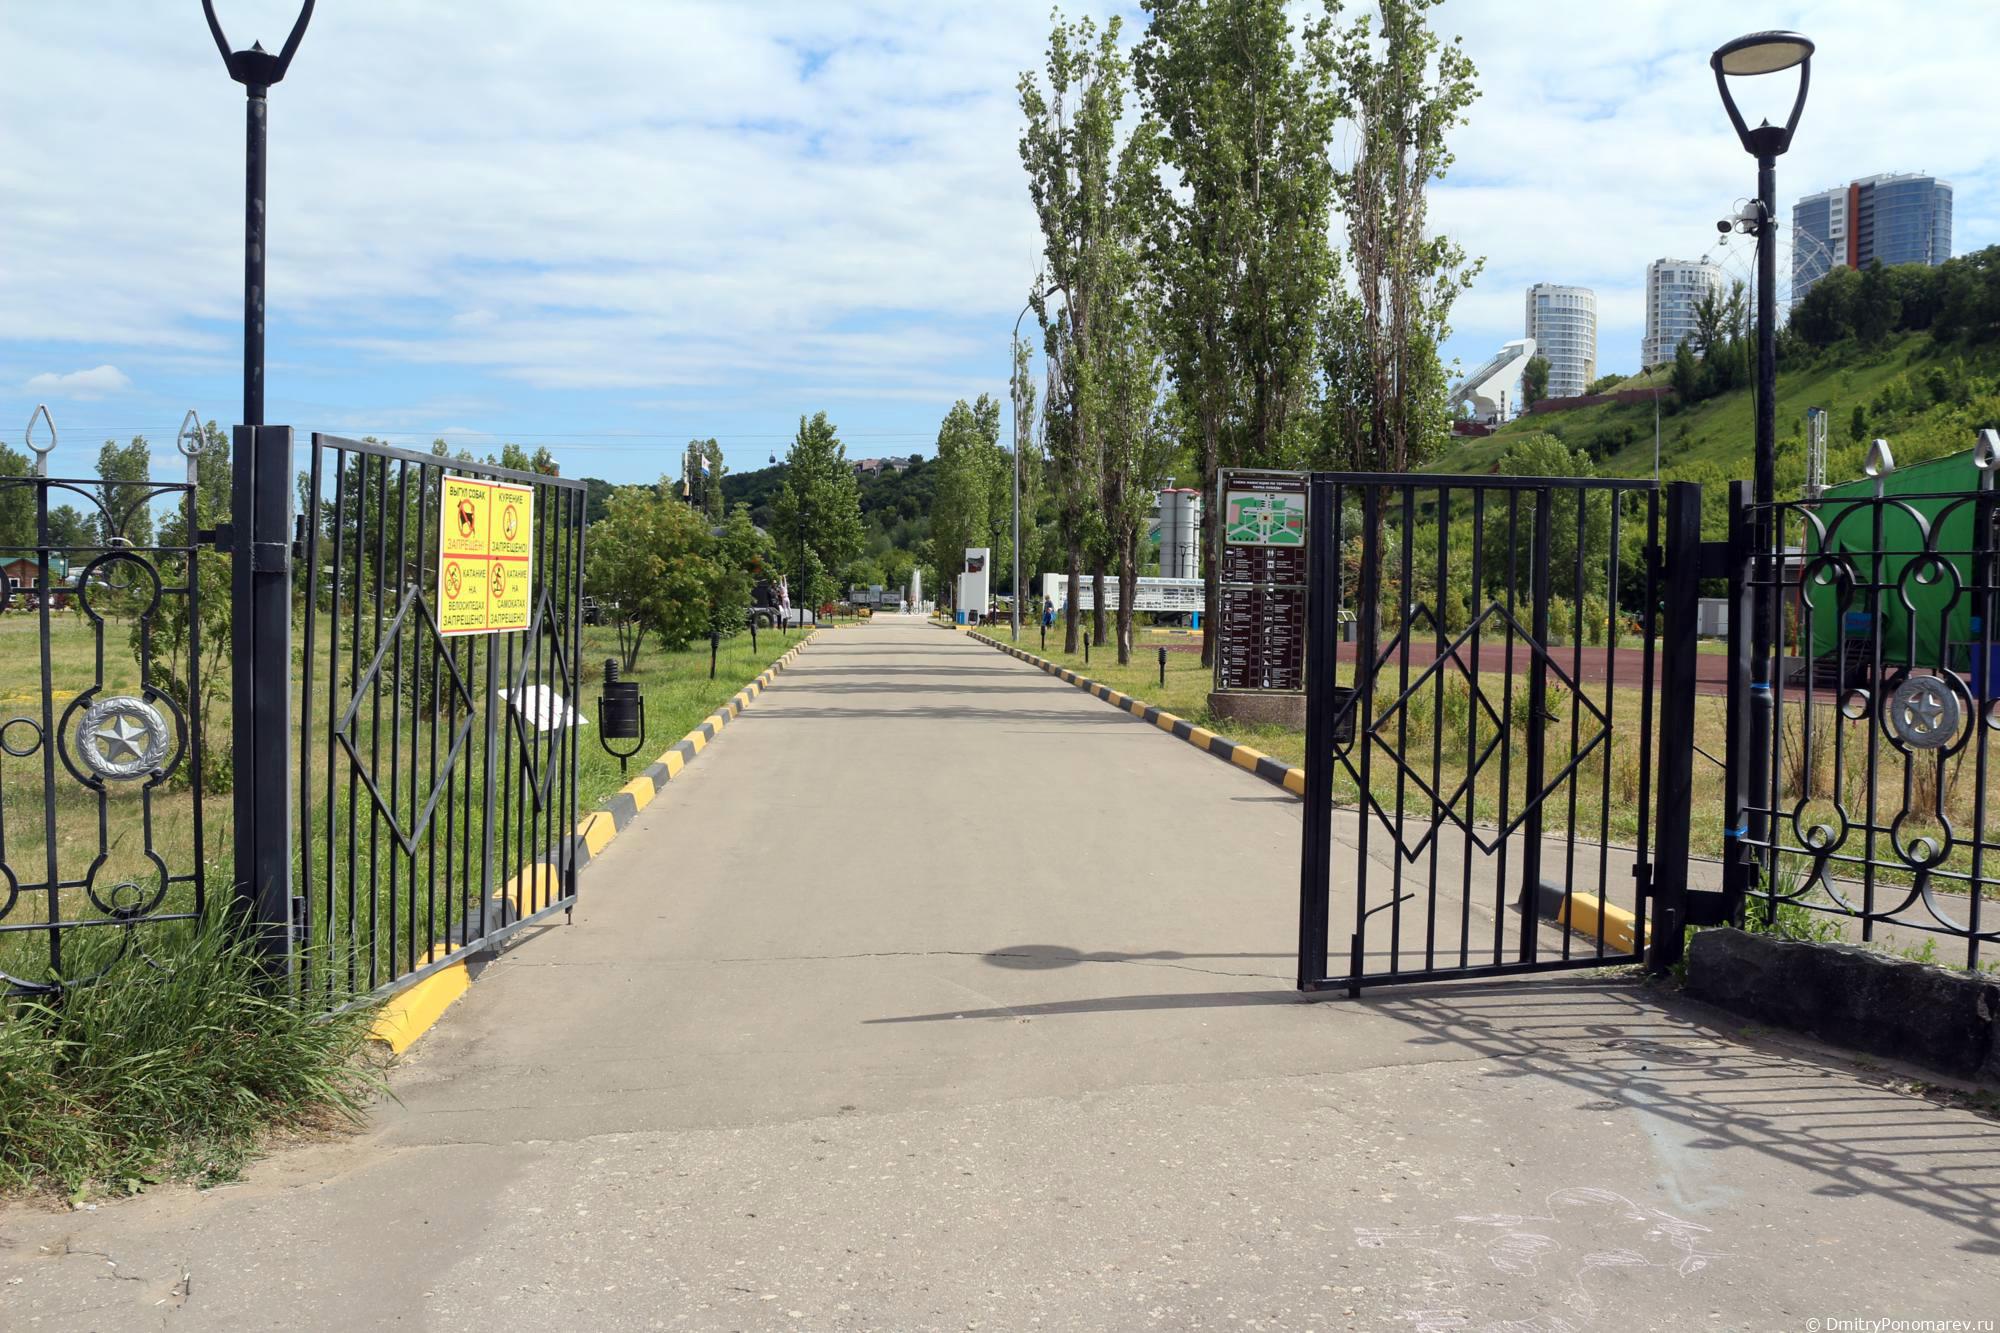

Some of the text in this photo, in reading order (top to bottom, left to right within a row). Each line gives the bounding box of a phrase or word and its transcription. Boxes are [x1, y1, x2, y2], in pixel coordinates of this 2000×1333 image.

[449, 486, 485, 500] ВЫГУЛ СОБАК
[499, 493, 524, 504] КУРЕНИЕ
[463, 569, 486, 578] КАТАНИЕ
[507, 570, 526, 578] КАТАНИЕ
[448, 601, 485, 610] ВЕЛОСИПЕДАХ
[497, 600, 525, 608] САМОКАТАХ
[443, 614, 486, 626] ЗАПРЕЩЕНО!
